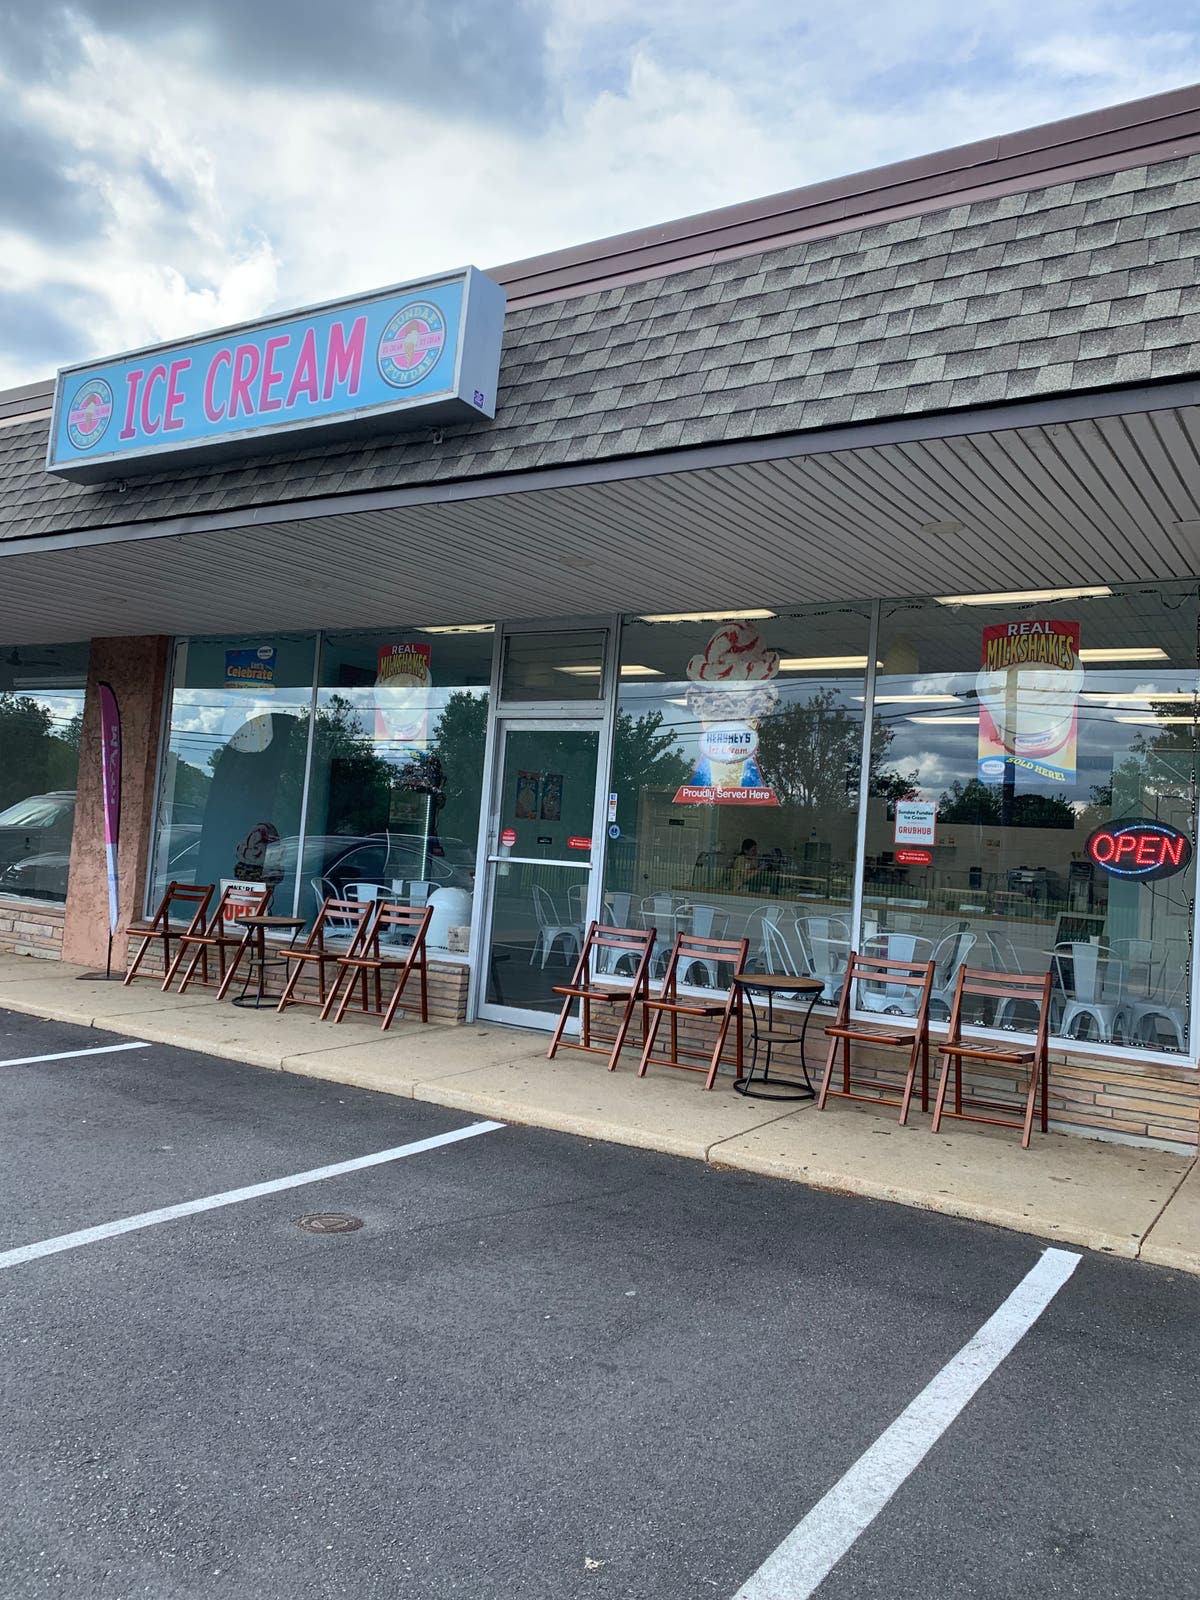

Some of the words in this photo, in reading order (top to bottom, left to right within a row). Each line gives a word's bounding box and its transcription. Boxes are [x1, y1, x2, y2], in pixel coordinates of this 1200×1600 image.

[119, 358, 191, 441] ICE
[204, 316, 368, 423] CREAM
[1007, 622, 1055, 636] REAL
[391, 645, 417, 655] REAL
[986, 634, 1075, 671] MILKSHAKES
[227, 665, 273, 681] Celebrate
[380, 653, 428, 682] MILKSHAKES
[706, 732, 751, 744] HERSHEY'S
[1006, 757, 1034, 770] SOLD
[1034, 765, 1066, 782] HERE!
[682, 788, 715, 800] Proudly
[717, 789, 747, 799] Served
[749, 790, 770, 799] Here
[898, 826, 932, 835] GRUBHUB
[1092, 833, 1185, 866] OPEN
[224, 903, 258, 921] OPE
